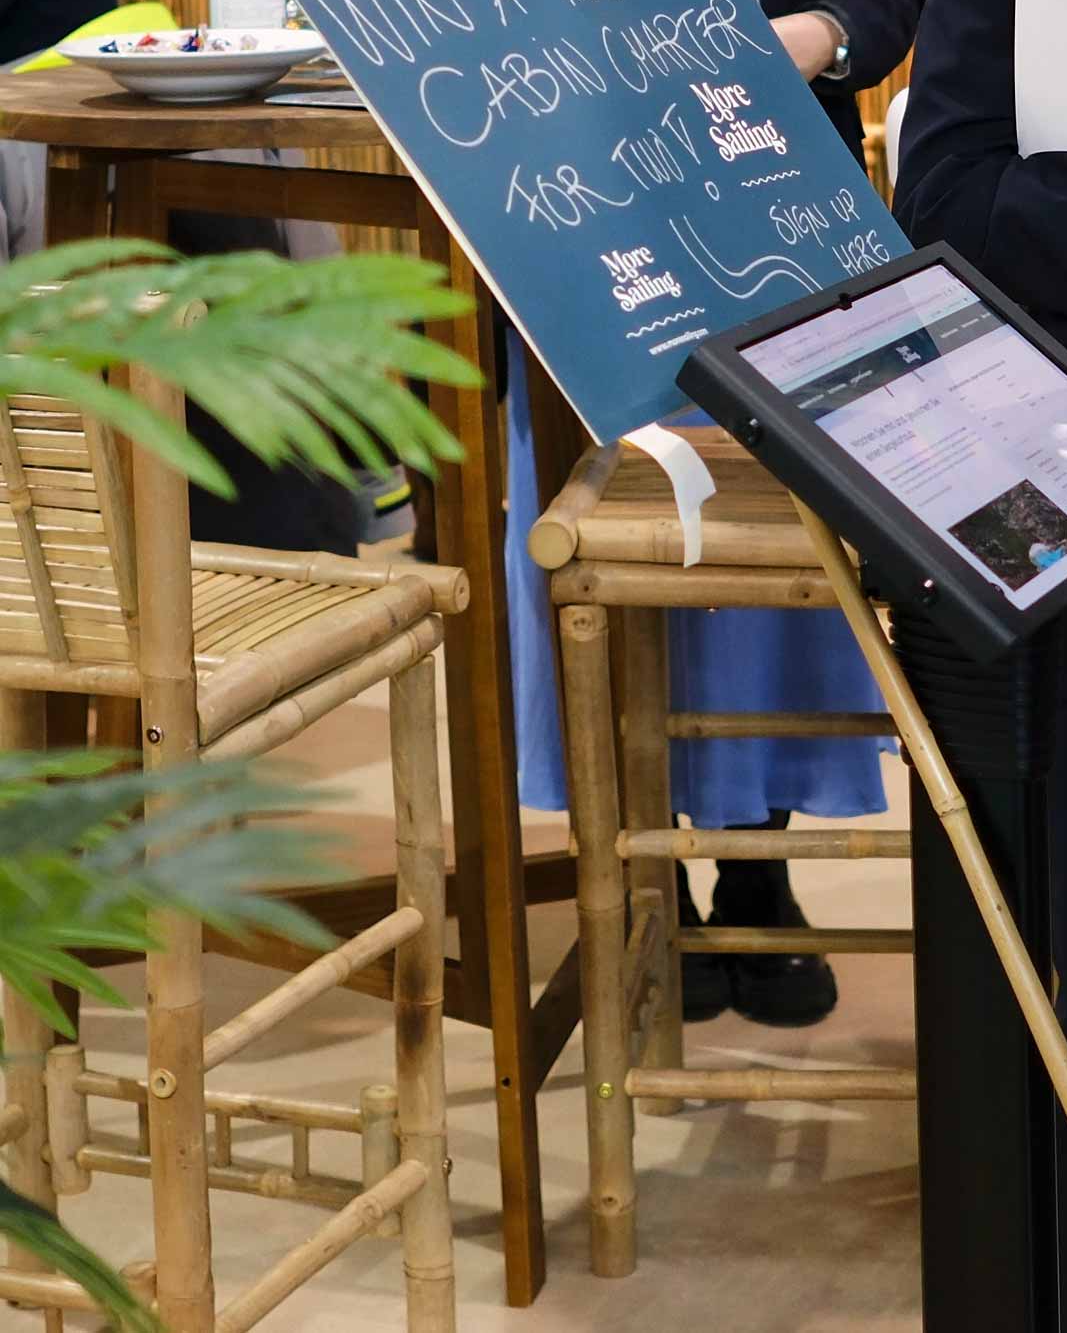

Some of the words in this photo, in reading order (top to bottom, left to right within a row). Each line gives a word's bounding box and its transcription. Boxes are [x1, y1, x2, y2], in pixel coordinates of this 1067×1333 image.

[689, 81, 751, 123] More
[506, 165, 634, 231] FOR
[830, 188, 860, 222] UP
[600, 245, 655, 283] More
